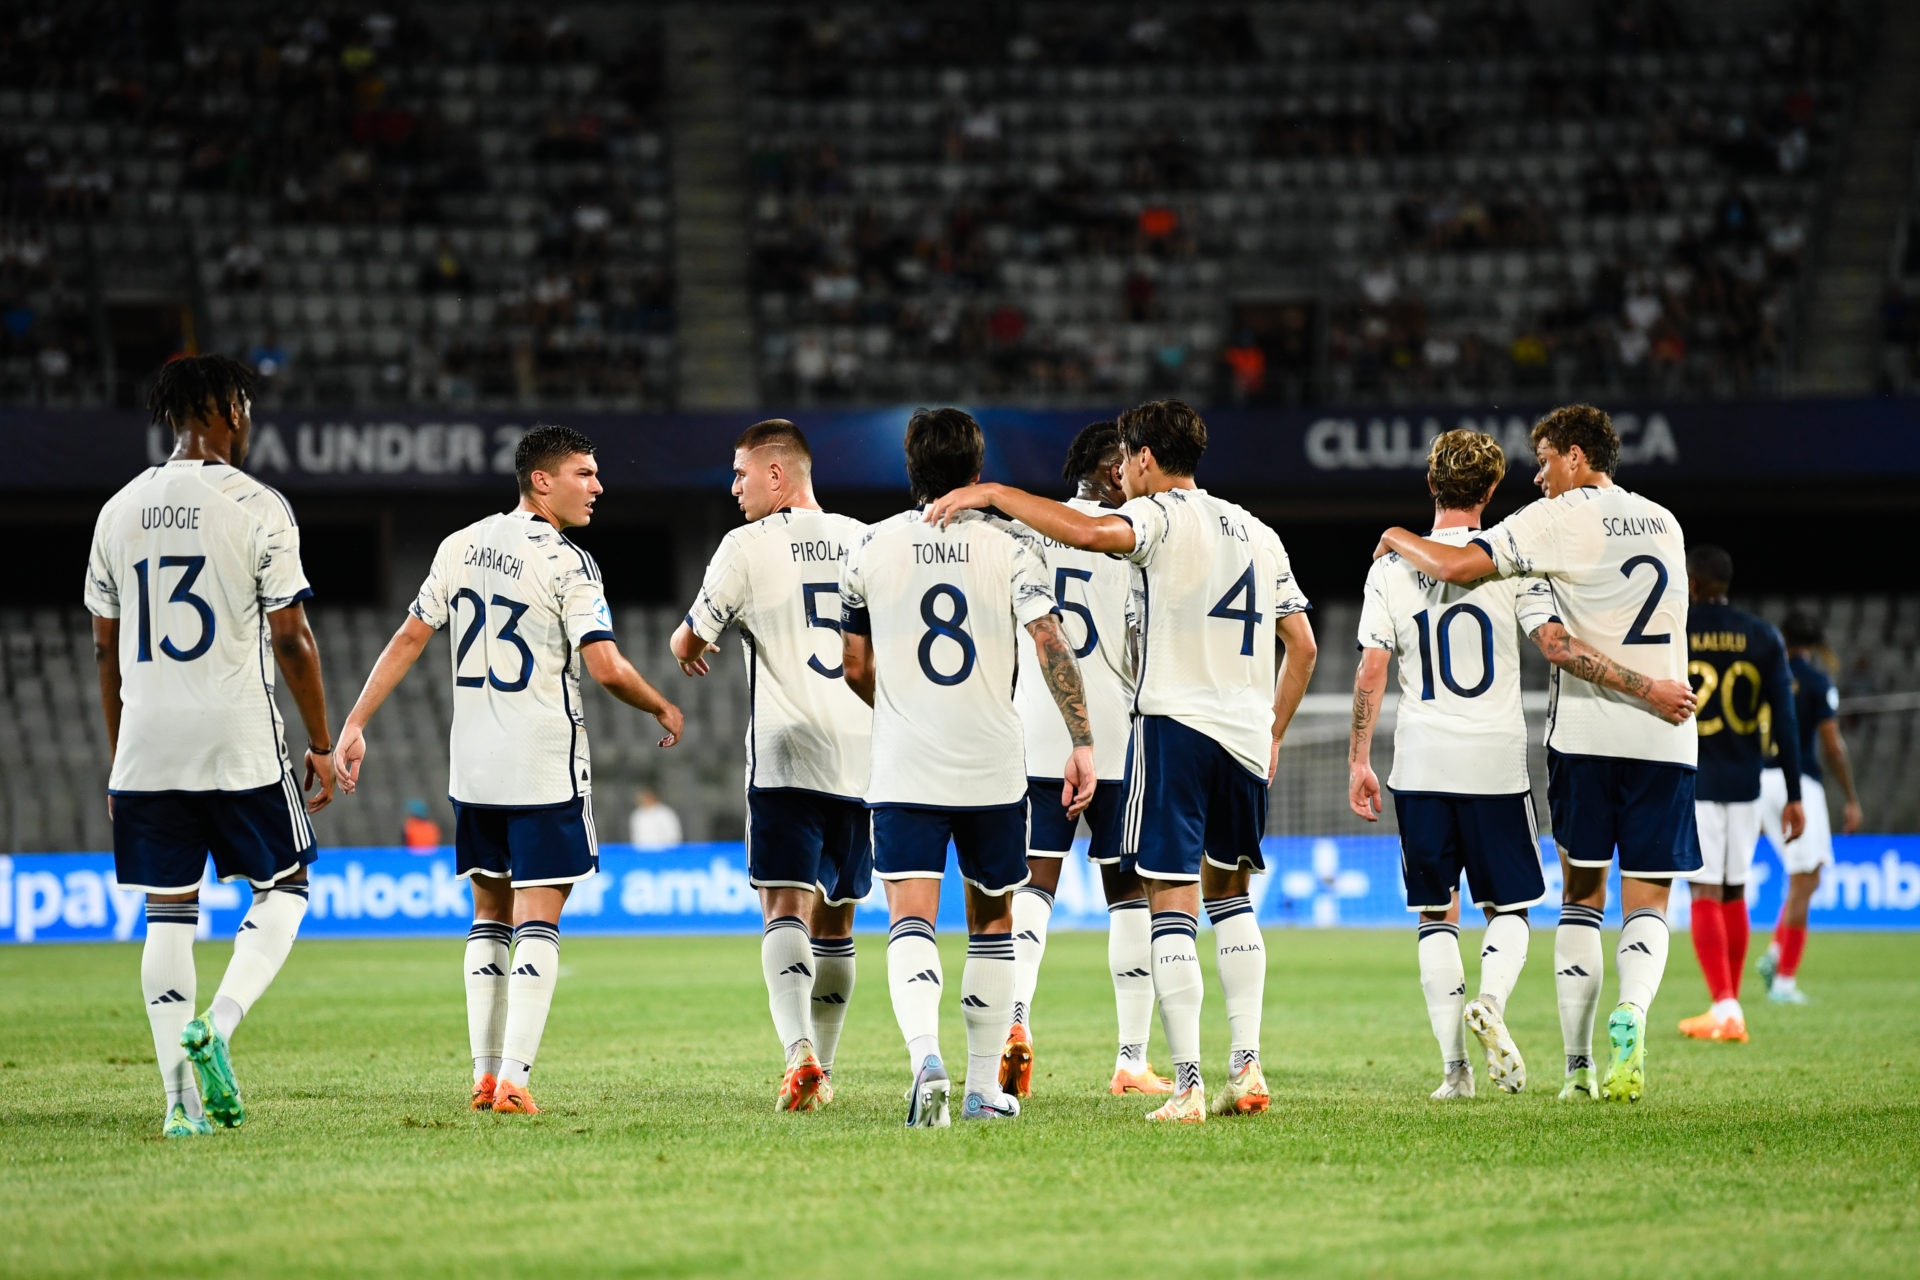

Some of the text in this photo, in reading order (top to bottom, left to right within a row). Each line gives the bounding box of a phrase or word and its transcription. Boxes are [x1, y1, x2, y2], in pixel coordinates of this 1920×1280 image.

[297, 421, 485, 475] UNDER
[142, 506, 200, 530] UDOGIE
[791, 540, 844, 562] PIROLA
[912, 542, 970, 564] TONALI
[1603, 516, 1668, 538] SCALVINI
[133, 555, 216, 662] 13
[918, 583, 976, 686] 8
[1054, 567, 1099, 660] 5
[1208, 560, 1263, 656] 4
[1620, 554, 1671, 645] 2
[450, 587, 534, 692] 23
[1412, 603, 1495, 701] 10
[1688, 660, 1761, 736] 20
[306, 861, 471, 919] nlock
[1220, 944, 1261, 956] ITALIA
